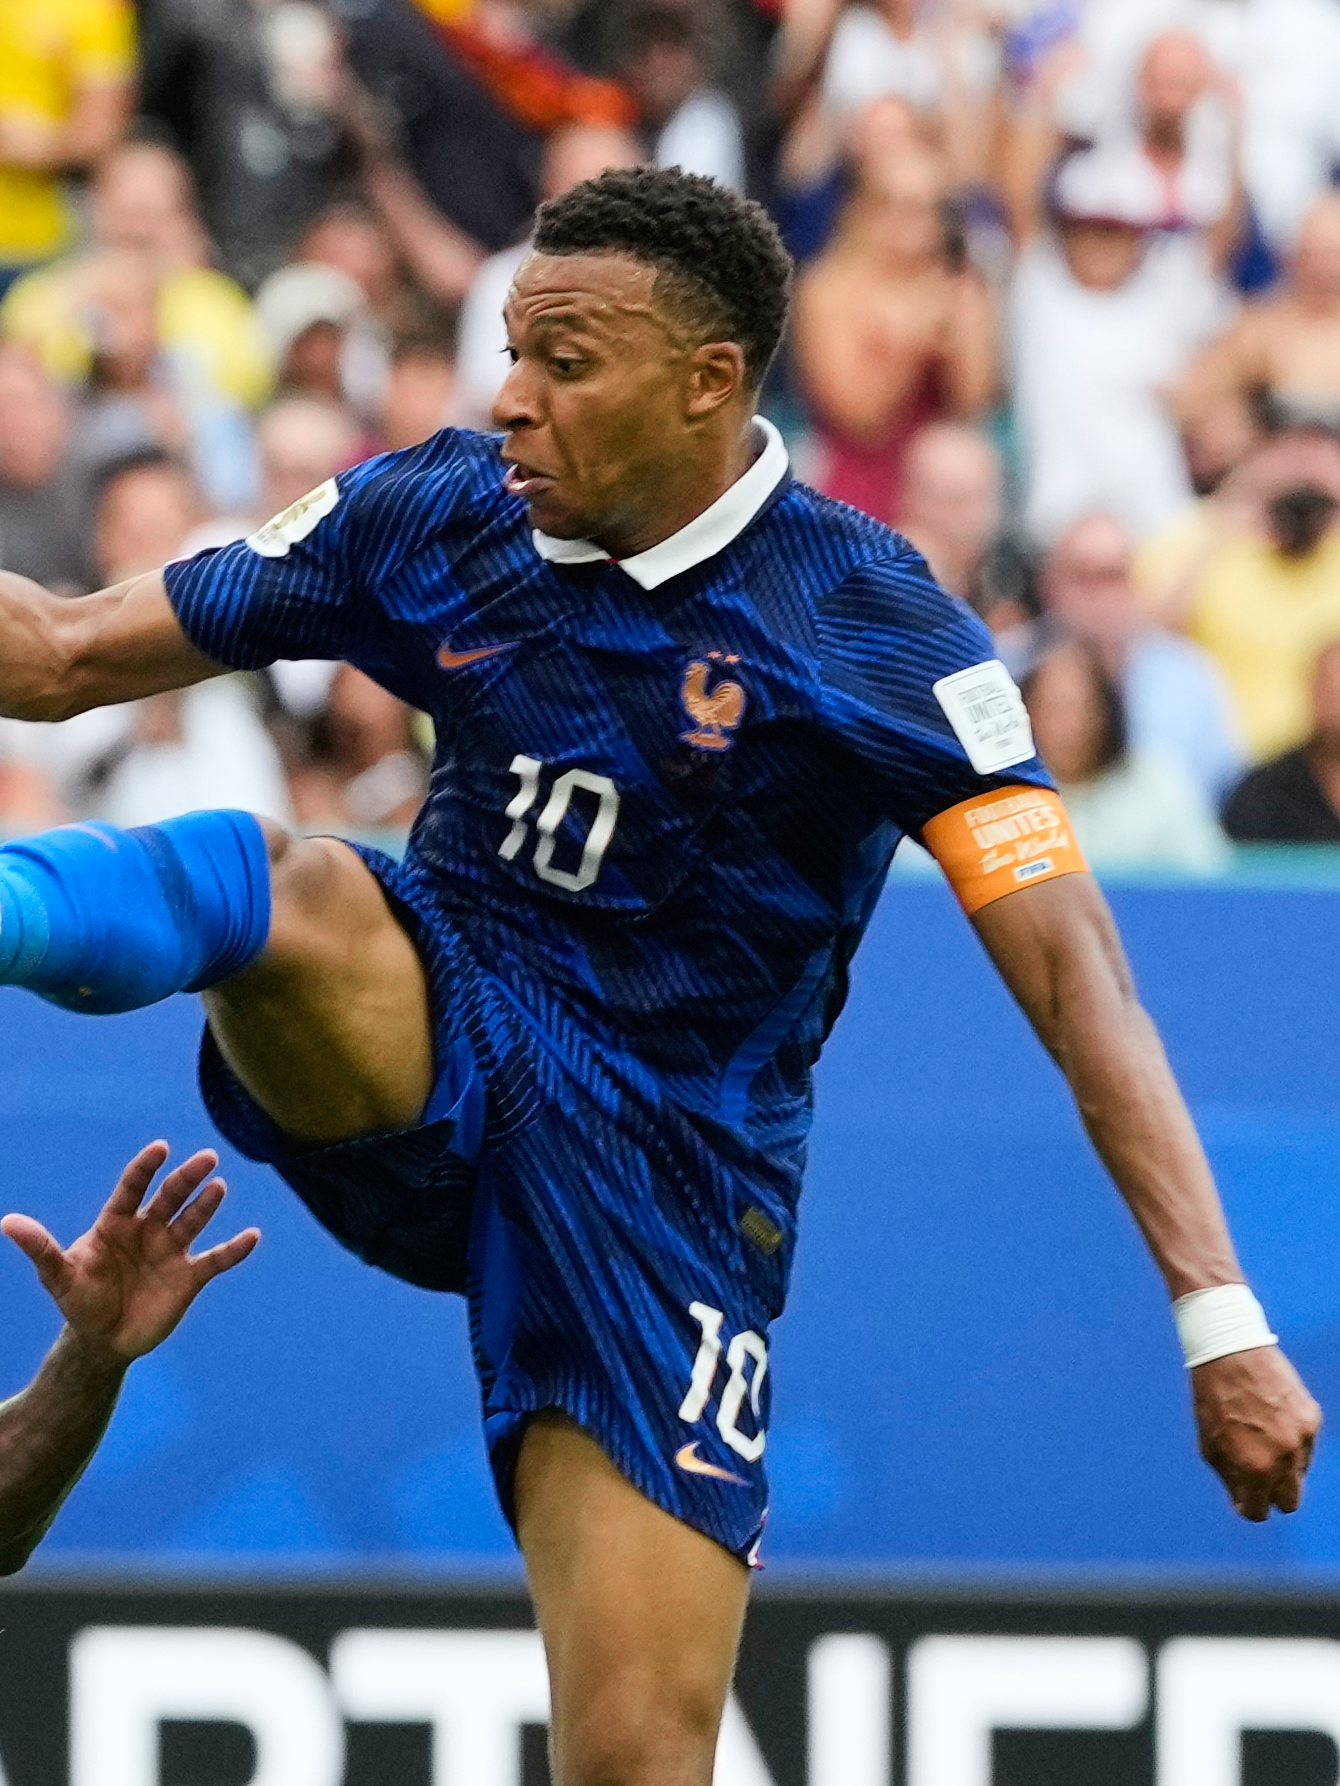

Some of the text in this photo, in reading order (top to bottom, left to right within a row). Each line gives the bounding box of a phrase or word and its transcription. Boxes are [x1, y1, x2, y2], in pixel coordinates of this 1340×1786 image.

[498, 754, 621, 892] 10
[971, 805, 1061, 849] UNITES
[678, 1301, 768, 1462] 10
